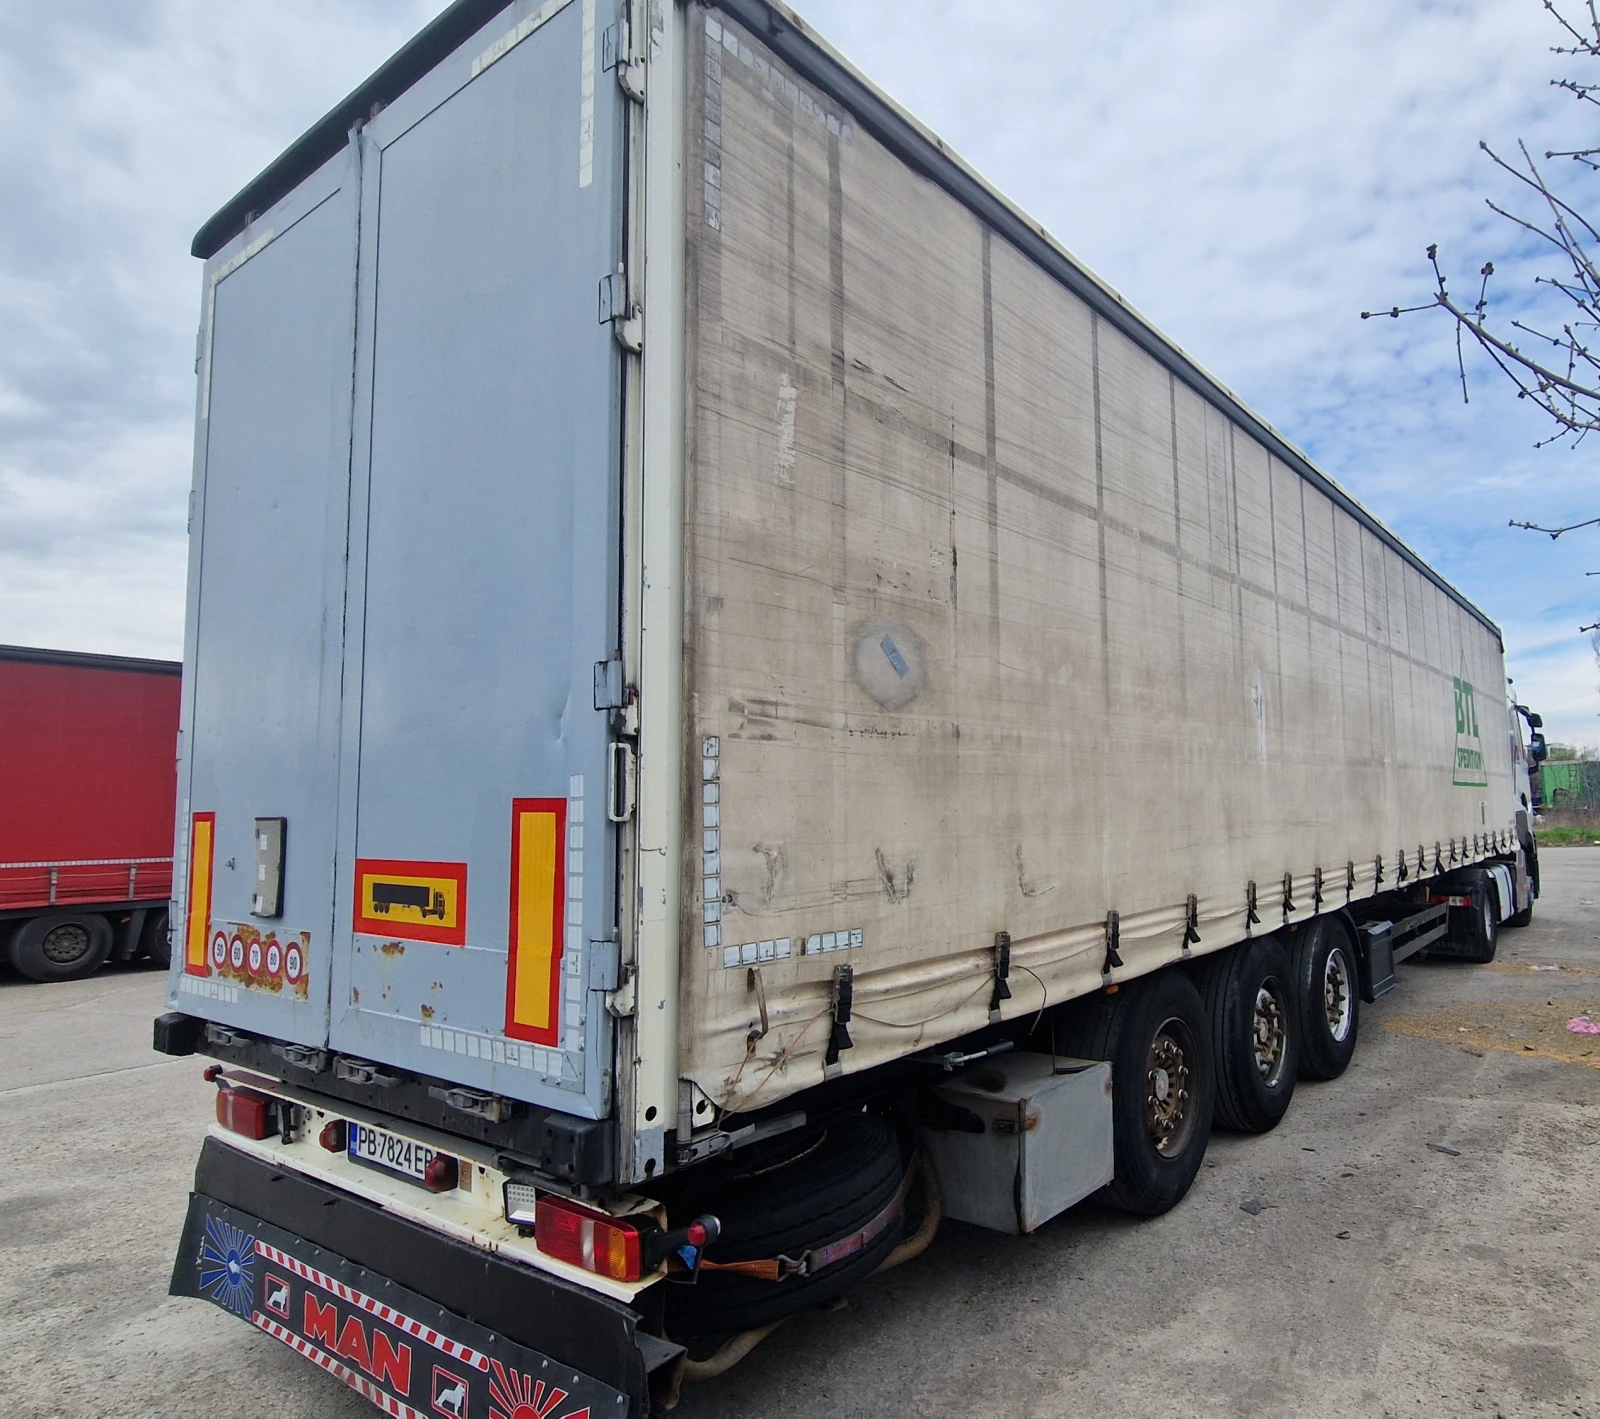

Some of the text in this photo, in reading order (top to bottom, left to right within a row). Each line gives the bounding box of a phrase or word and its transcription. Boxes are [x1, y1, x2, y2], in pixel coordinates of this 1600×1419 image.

[1453, 675, 1480, 739] BTL
[1457, 747, 1483, 770] SPEDITION
[216, 943, 298, 971] 50 60 70 80 90
[303, 1290, 412, 1397] MAN
